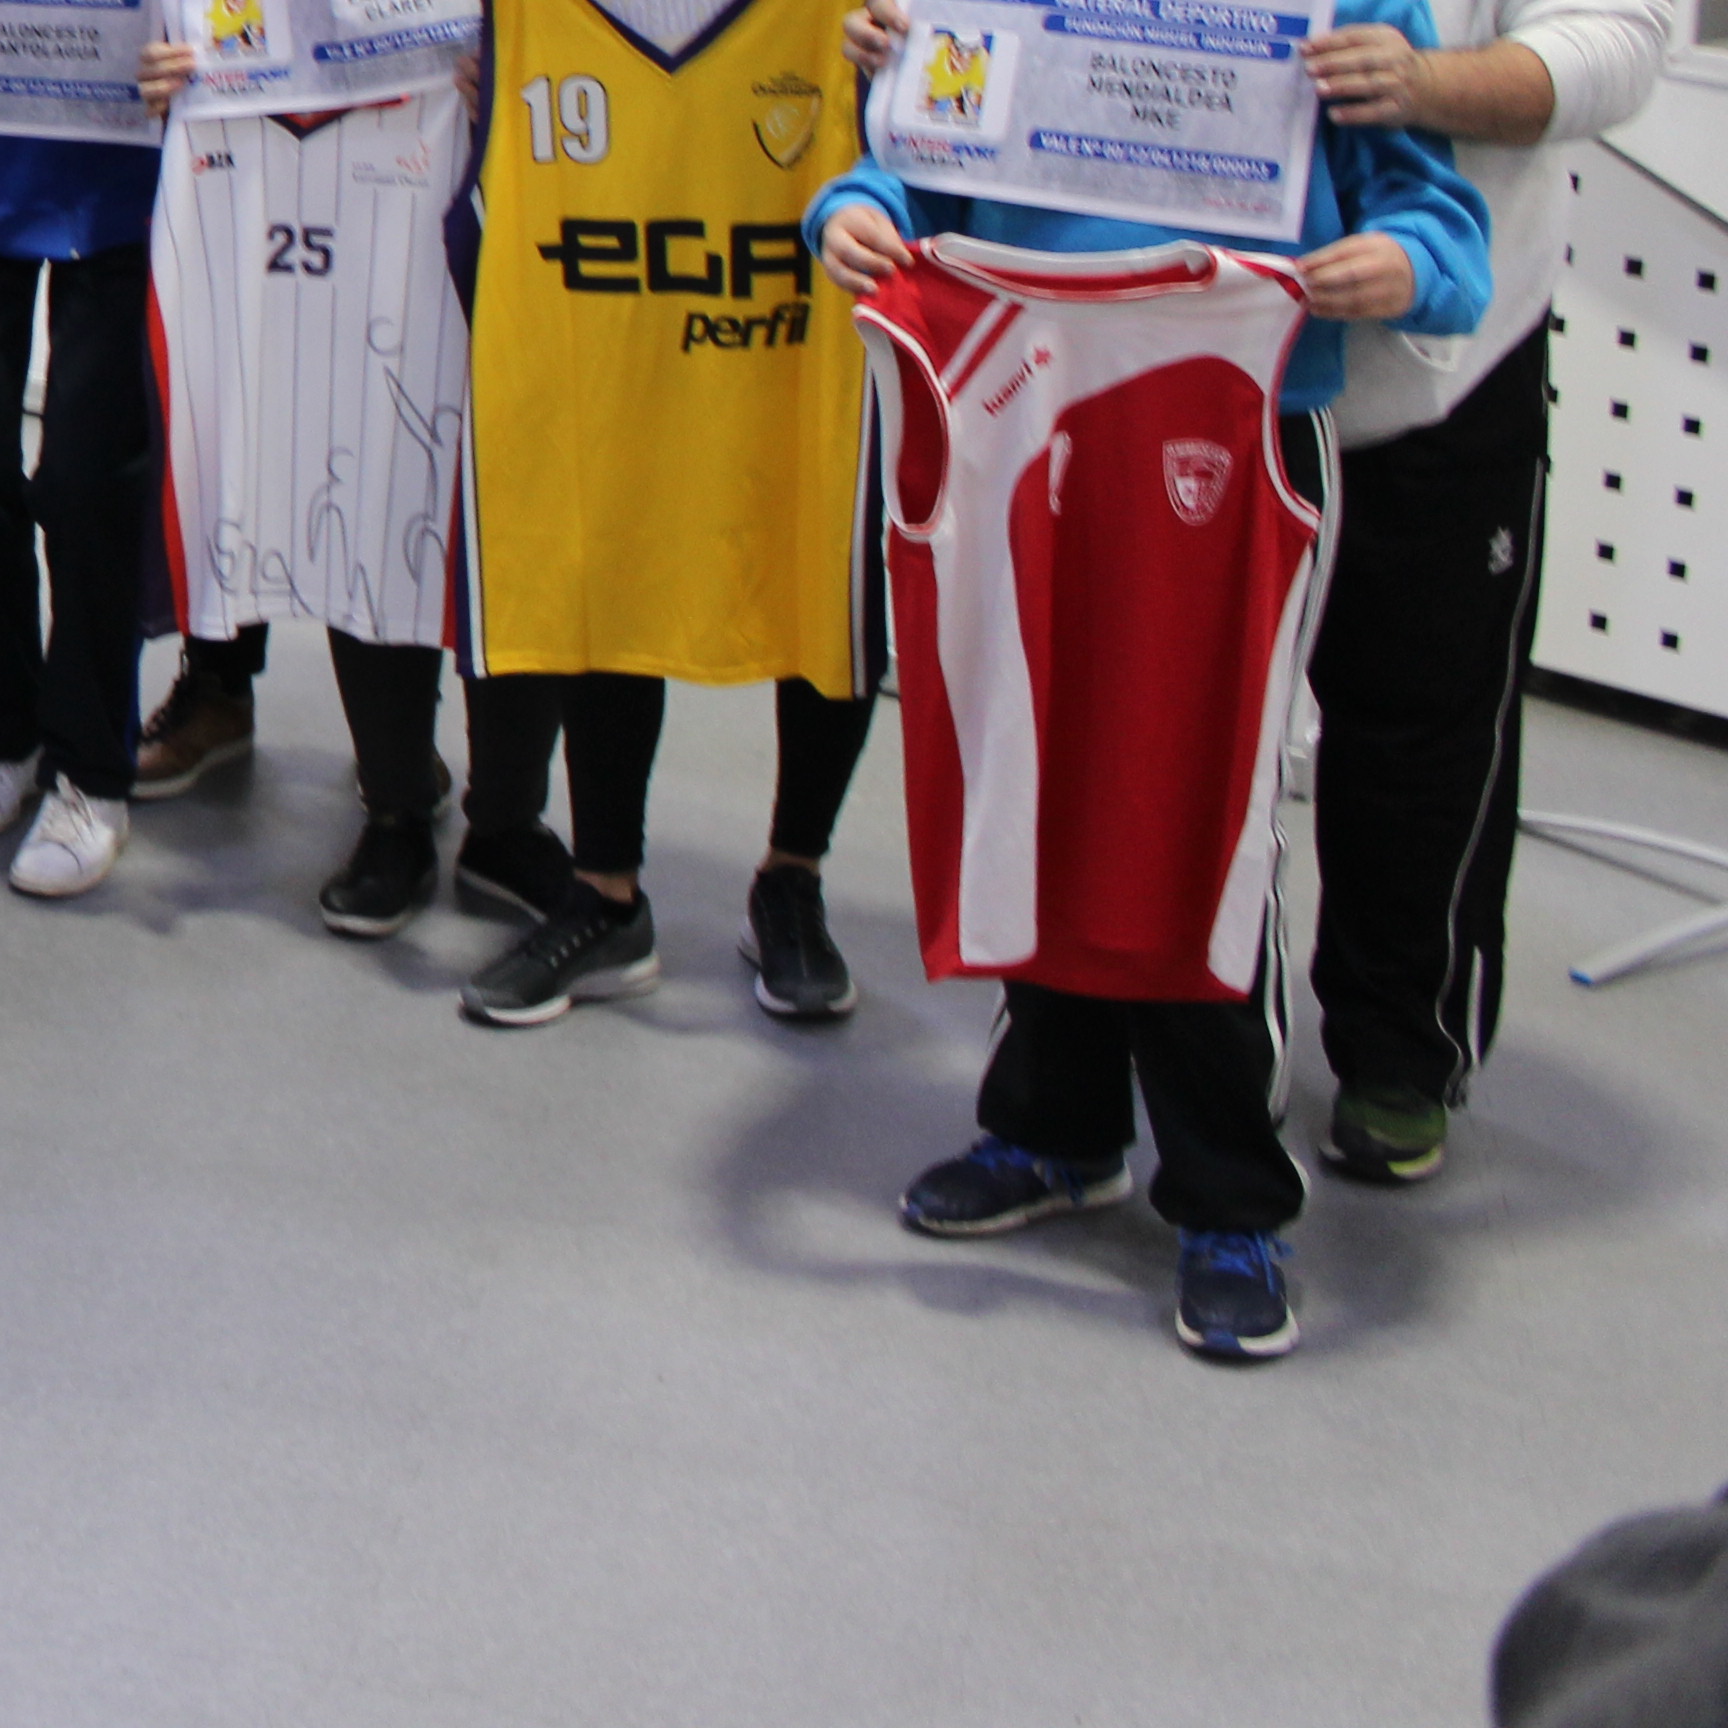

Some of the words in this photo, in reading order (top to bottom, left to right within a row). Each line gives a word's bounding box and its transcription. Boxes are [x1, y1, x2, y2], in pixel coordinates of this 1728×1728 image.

[1158, 0, 1278, 35] DEPORTIVO
[1090, 51, 1239, 89] BALONCESTO
[520, 74, 611, 164] 19
[266, 223, 335, 277] 25
[681, 302, 811, 355] perfil
